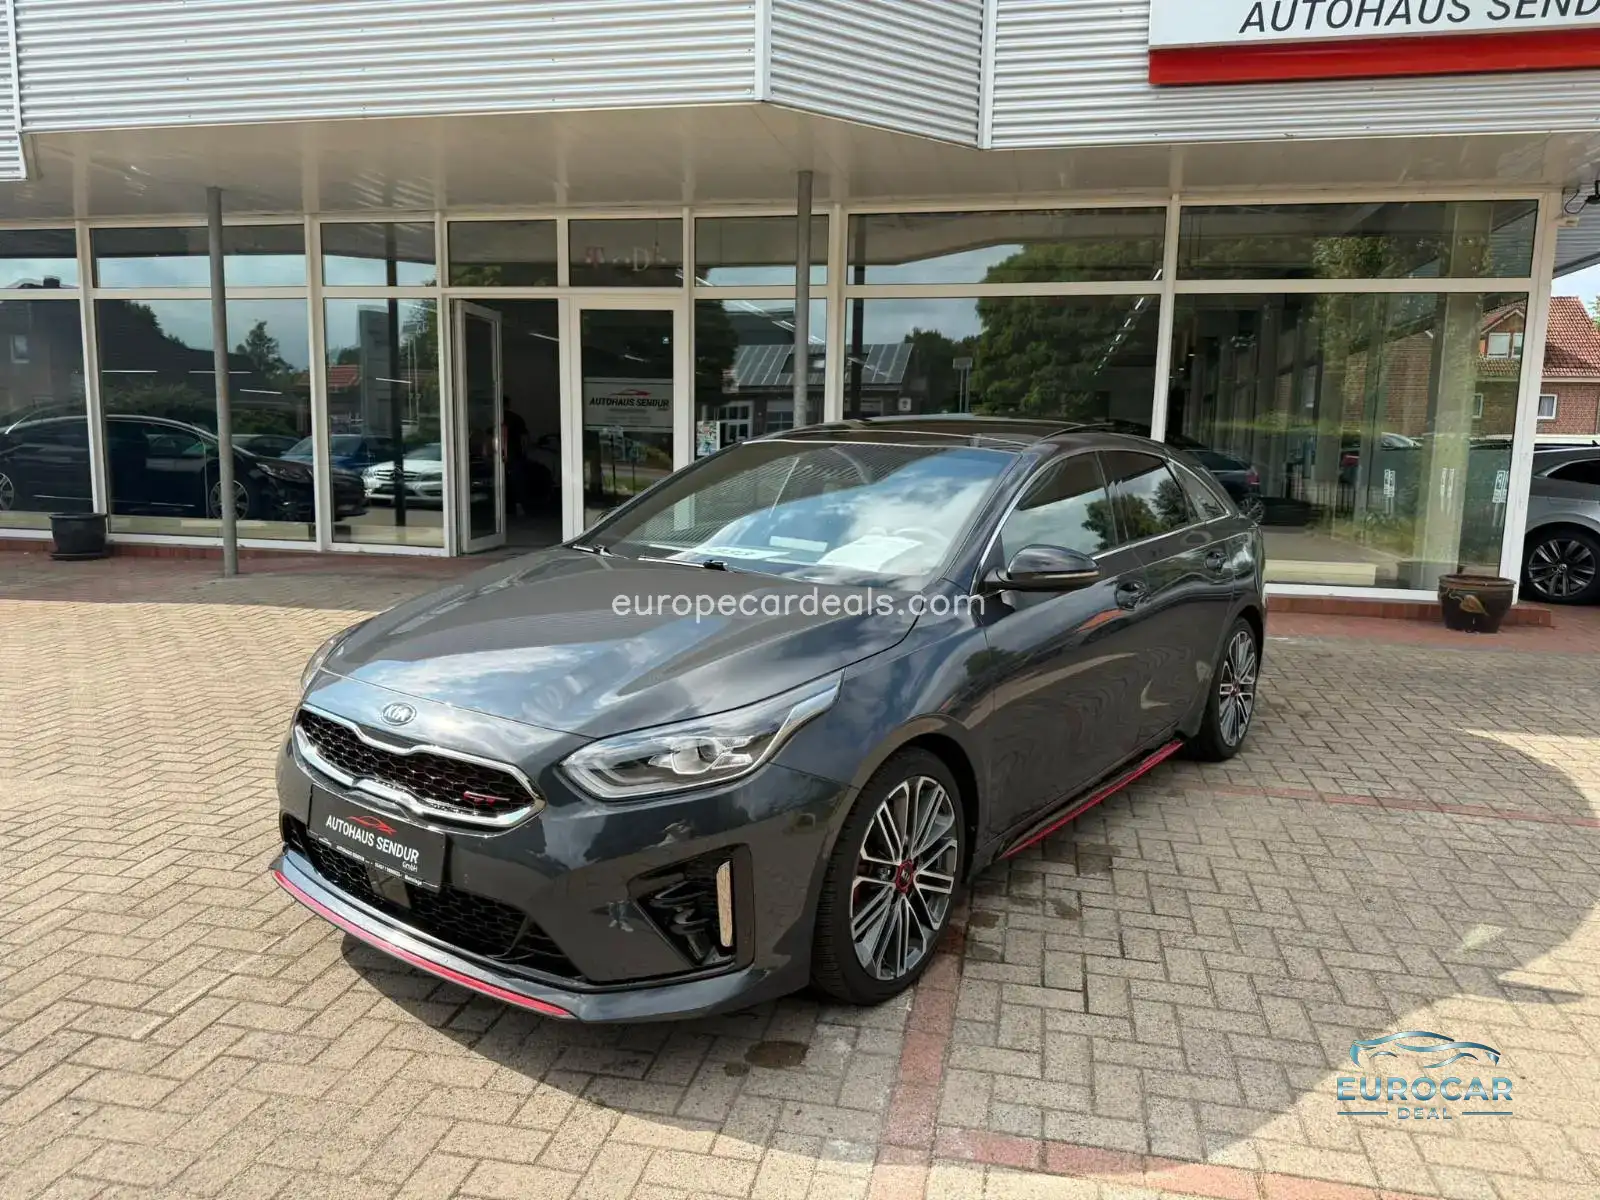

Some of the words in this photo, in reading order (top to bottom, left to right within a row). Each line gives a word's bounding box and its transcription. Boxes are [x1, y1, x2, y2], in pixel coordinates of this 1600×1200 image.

[1239, 0, 1471, 33] AUTOHAUS
[589, 397, 634, 406] AUTOHAUS
[635, 398, 670, 407] SENDUR
[325, 815, 374, 847] AUTOHAUS
[376, 836, 420, 864] SENDUR
